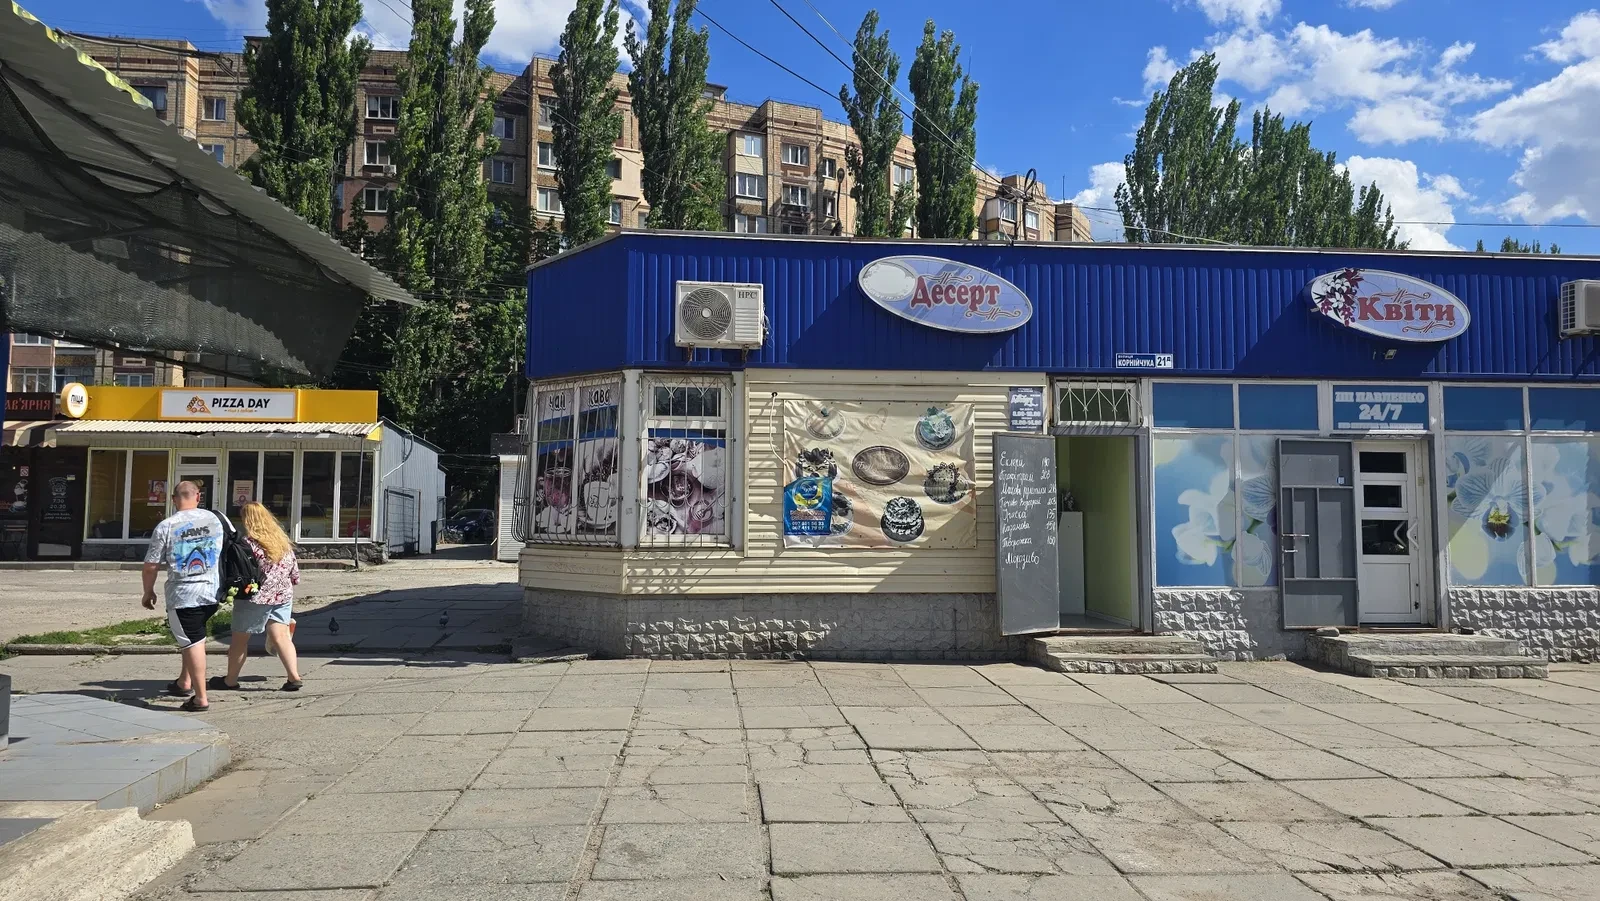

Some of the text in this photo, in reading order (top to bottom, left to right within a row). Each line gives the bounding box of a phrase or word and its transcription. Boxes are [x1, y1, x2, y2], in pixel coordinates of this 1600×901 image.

[738, 291, 757, 299] HPC
[910, 275, 1000, 312] Десерт
[1357, 296, 1456, 321] Квіти
[1117, 358, 1155, 367] КОРНІЙЧУКА
[211, 397, 271, 409] PIZZA DAY
[1355, 391, 1425, 403] ПАВЛЕНКО
[1358, 403, 1403, 421] 24/7
[181, 526, 210, 538] JAWS
